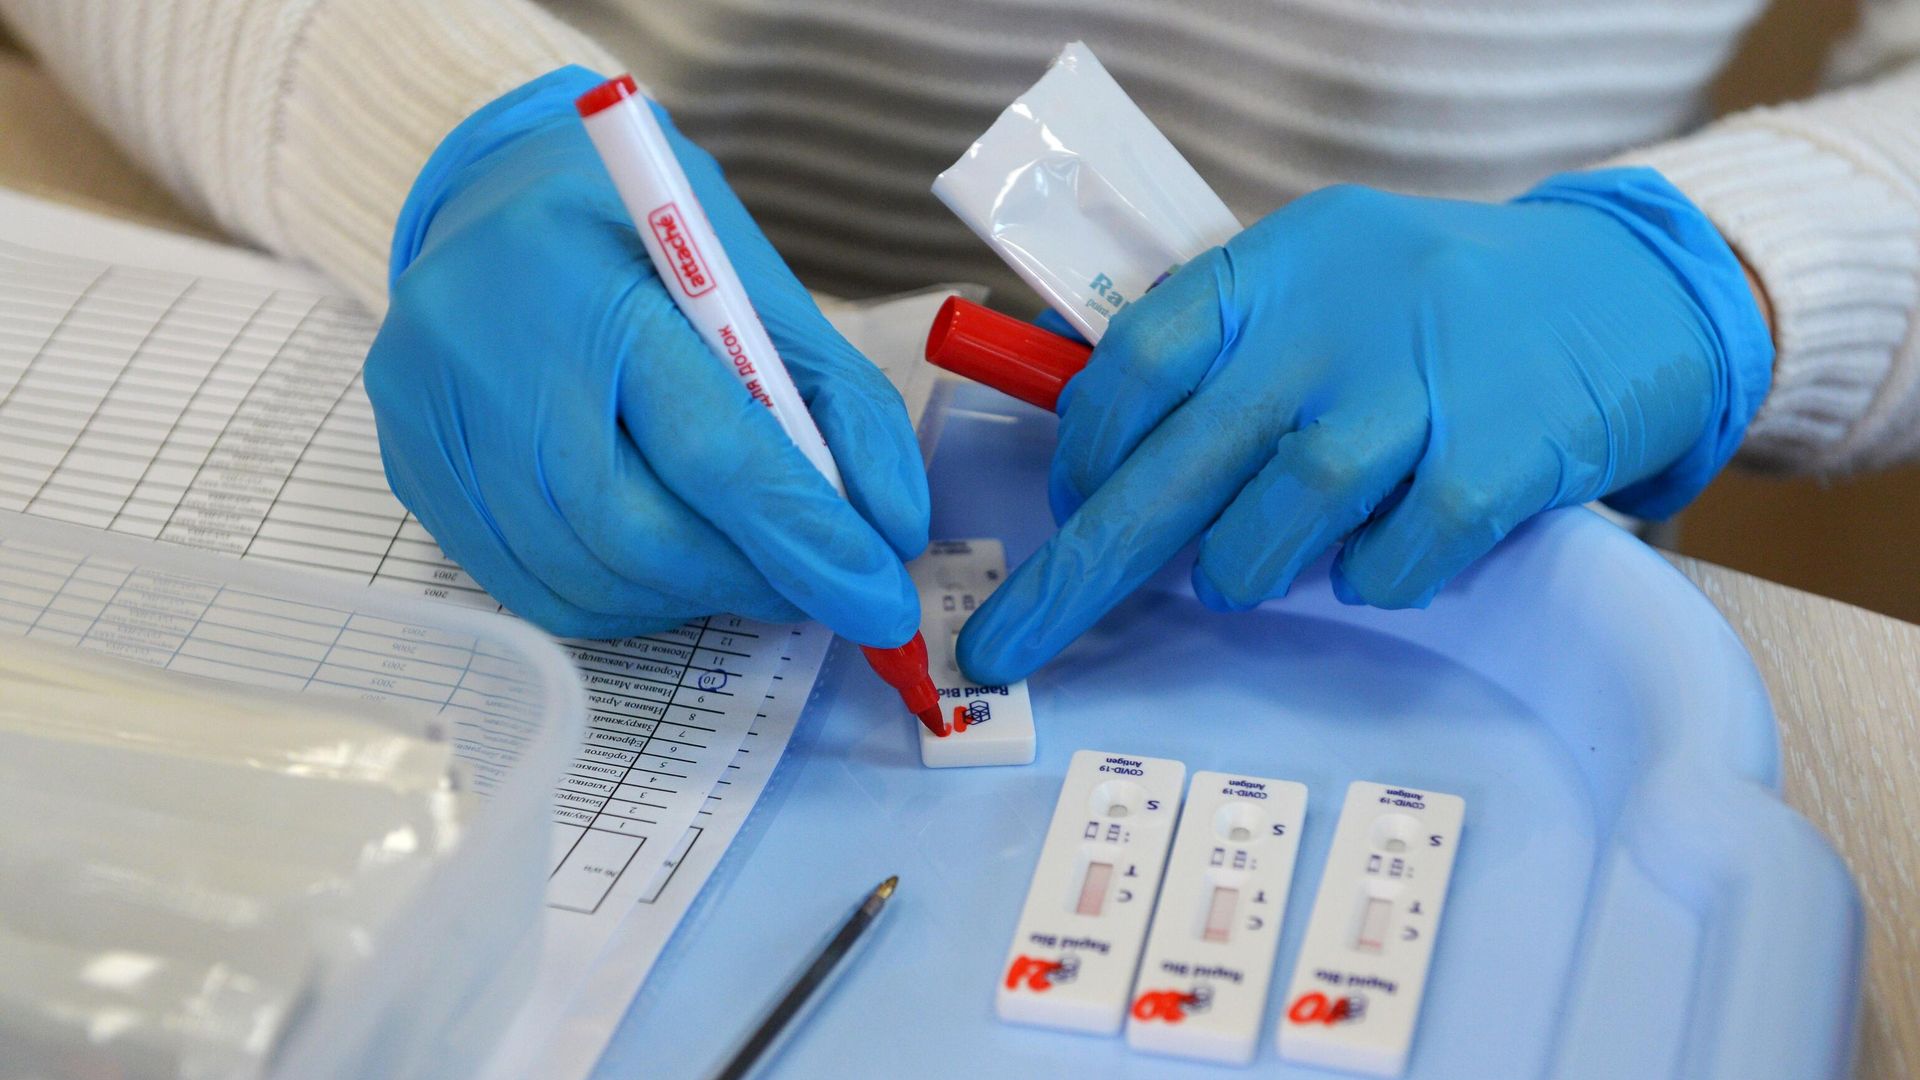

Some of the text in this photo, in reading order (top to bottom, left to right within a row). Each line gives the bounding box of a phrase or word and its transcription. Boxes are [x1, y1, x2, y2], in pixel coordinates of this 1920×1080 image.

[655, 212, 705, 288] attaché
[1089, 272, 1129, 311] Ra
[720, 637, 733, 646] 12
[713, 656, 724, 665] 11
[591, 675, 631, 691] Матвей
[704, 675, 716, 685] 10
[633, 682, 673, 698] Иванов
[964, 685, 1009, 698] Rapid
[624, 701, 663, 716] Иванов
[595, 733, 645, 748] Ефремов
[584, 748, 635, 763] Горбатов
[1106, 758, 1143, 768] Antigen
[1099, 765, 1144, 777] COVID-19
[1229, 780, 1266, 790] Antigen
[639, 791, 648, 799] 3
[1222, 788, 1268, 800] COVID-19
[1386, 788, 1424, 801] Antigen
[1146, 800, 1160, 811] S
[1379, 797, 1426, 810] COVID-19
[1272, 824, 1286, 836] S
[1429, 835, 1444, 847] S
[1124, 865, 1138, 878] T
[1117, 890, 1133, 903] C
[1252, 891, 1267, 904] T
[1408, 900, 1423, 915] T
[1247, 915, 1263, 931] C
[1402, 926, 1419, 941] C
